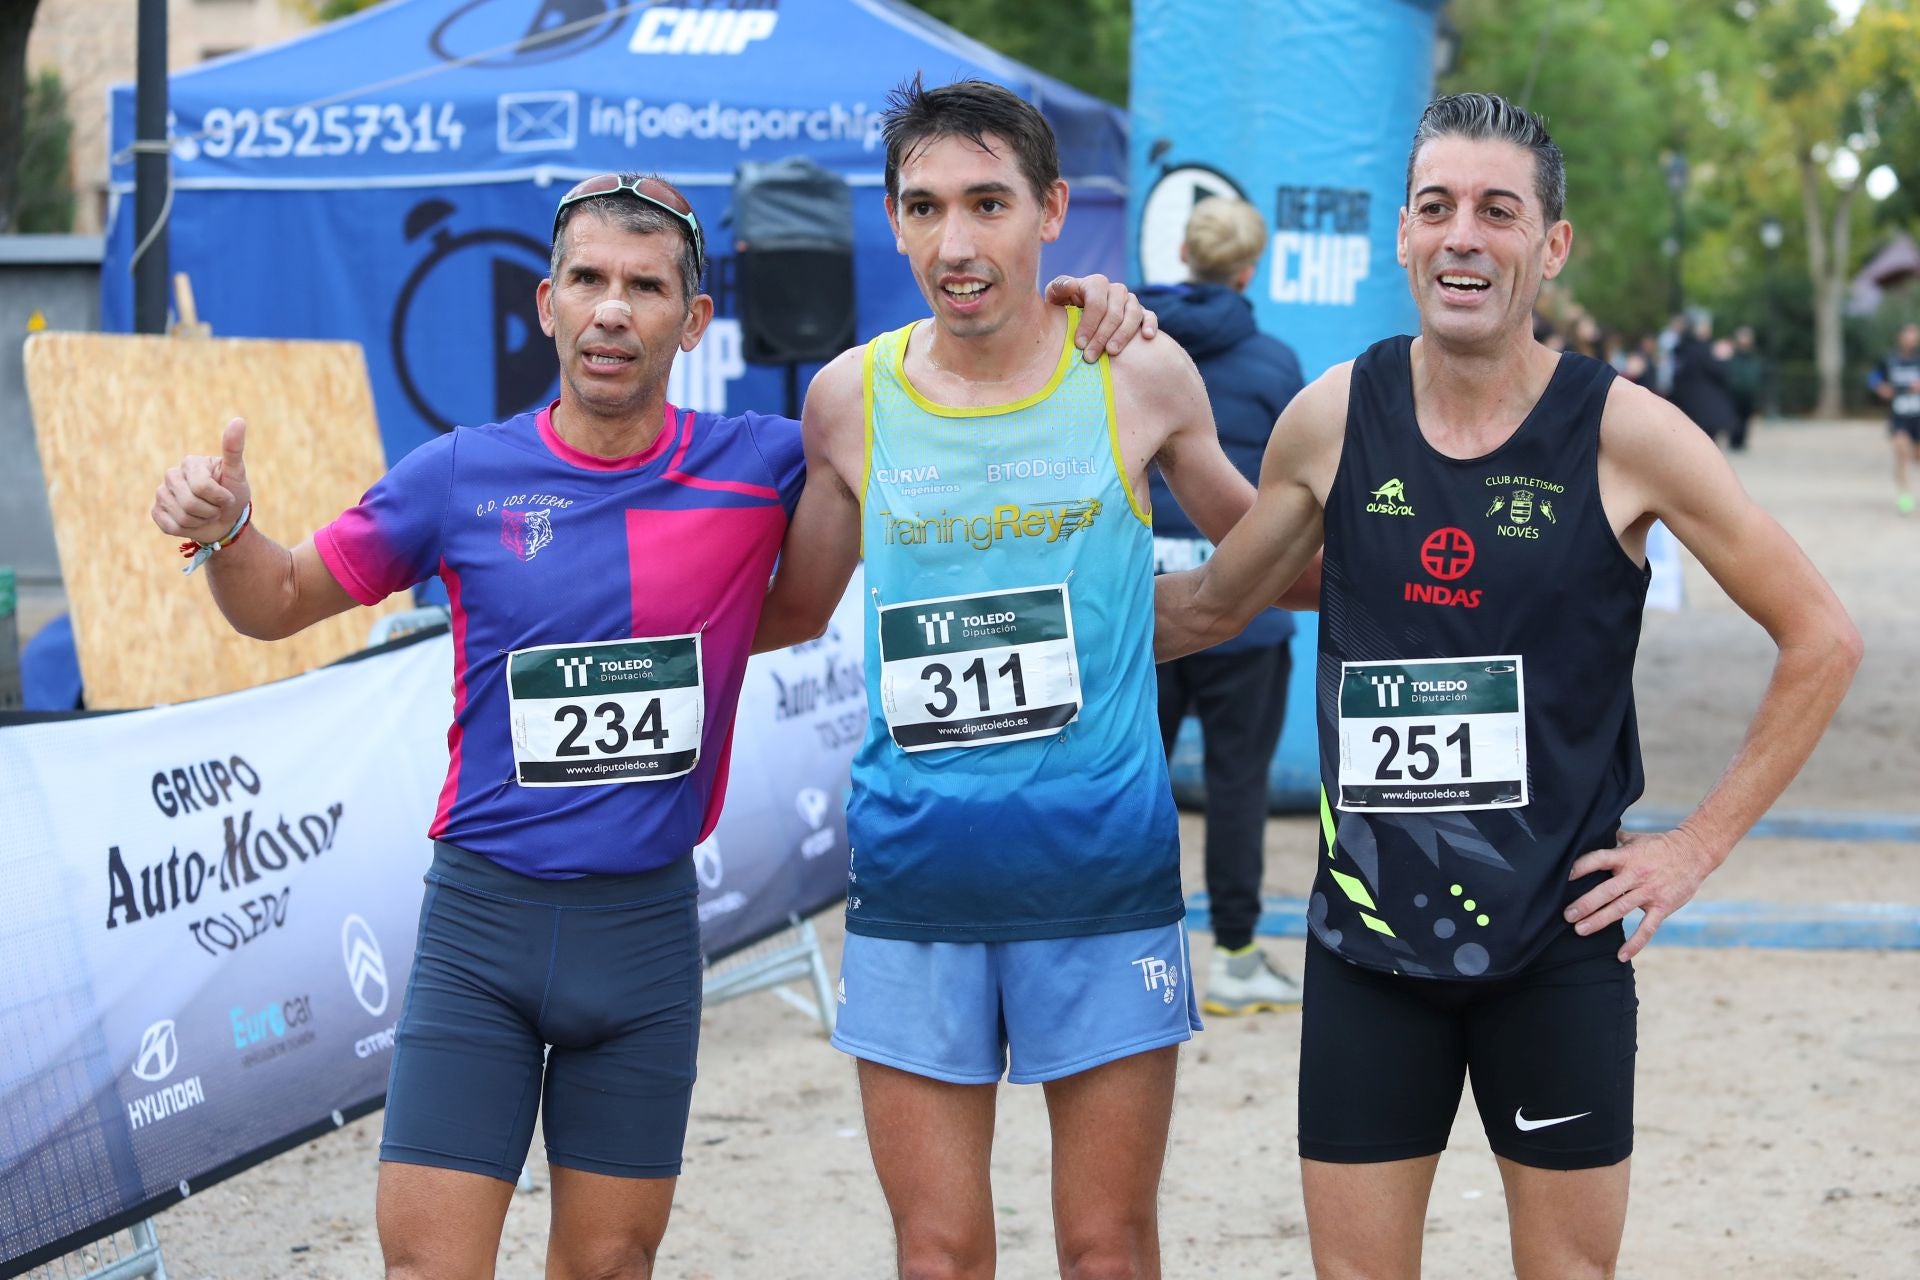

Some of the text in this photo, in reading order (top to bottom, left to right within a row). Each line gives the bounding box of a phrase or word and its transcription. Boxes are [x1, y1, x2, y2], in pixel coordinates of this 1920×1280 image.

[629, 7, 779, 55] CHIP
[203, 102, 465, 158] 925257314
[1269, 232, 1371, 306] CHIP
[876, 465, 940, 484] CURVA
[987, 456, 1097, 483] BTODigital
[901, 484, 961, 496] ingenieros
[1485, 476, 1564, 494] CLUB ATLETISMO
[503, 494, 527, 507] LOS
[528, 494, 574, 509] FIERAS
[880, 504, 1068, 550] TrainingRey
[1497, 525, 1539, 539] NOVÉS
[1405, 583, 1483, 608] INDAS
[961, 611, 1016, 627] TOLEDO
[962, 624, 1017, 637] Diputación
[600, 658, 653, 672] TOLEDO
[600, 670, 654, 682] Diputación
[920, 652, 1027, 718] 311
[1411, 680, 1468, 692] TOLEDO
[1411, 692, 1468, 703] Diputación
[553, 697, 669, 757] 234
[937, 717, 1029, 736] www.diputoledo.es
[1371, 722, 1473, 781] 251
[566, 759, 659, 776] www.diputoledo.es
[152, 755, 261, 818] GRUPO
[1381, 788, 1470, 801] www.diputoledo.es
[107, 802, 344, 929] Auto-Motor
[189, 887, 291, 957] TOLEDO
[128, 1076, 205, 1130] HYUNDAI
